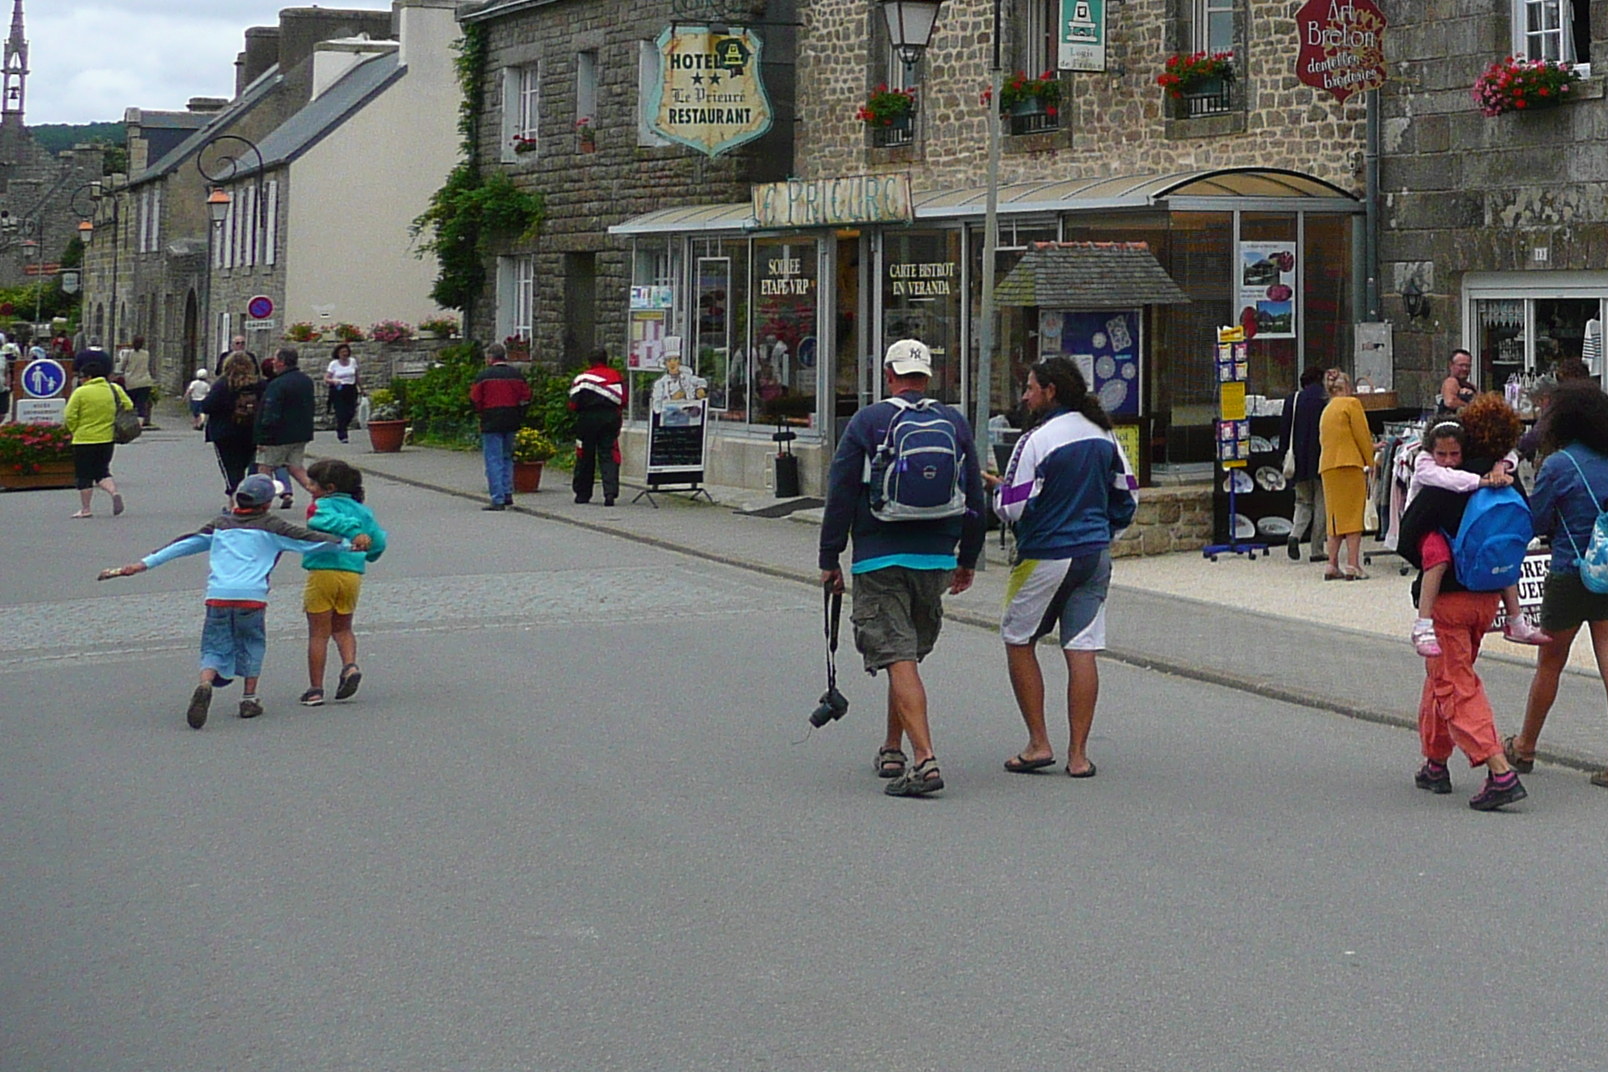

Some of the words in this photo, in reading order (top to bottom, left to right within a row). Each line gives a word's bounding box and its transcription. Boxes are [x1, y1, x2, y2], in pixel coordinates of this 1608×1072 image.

[1307, 20, 1374, 47] Breton
[670, 54, 722, 69] HOTEL
[671, 88, 691, 103] Le
[668, 108, 751, 124] RESTAURANT
[889, 263, 917, 278] CARTE
[919, 262, 955, 277] BISTROT
[790, 278, 809, 295] VRP
[893, 281, 905, 295] EN
[908, 280, 951, 295] VERANDA
